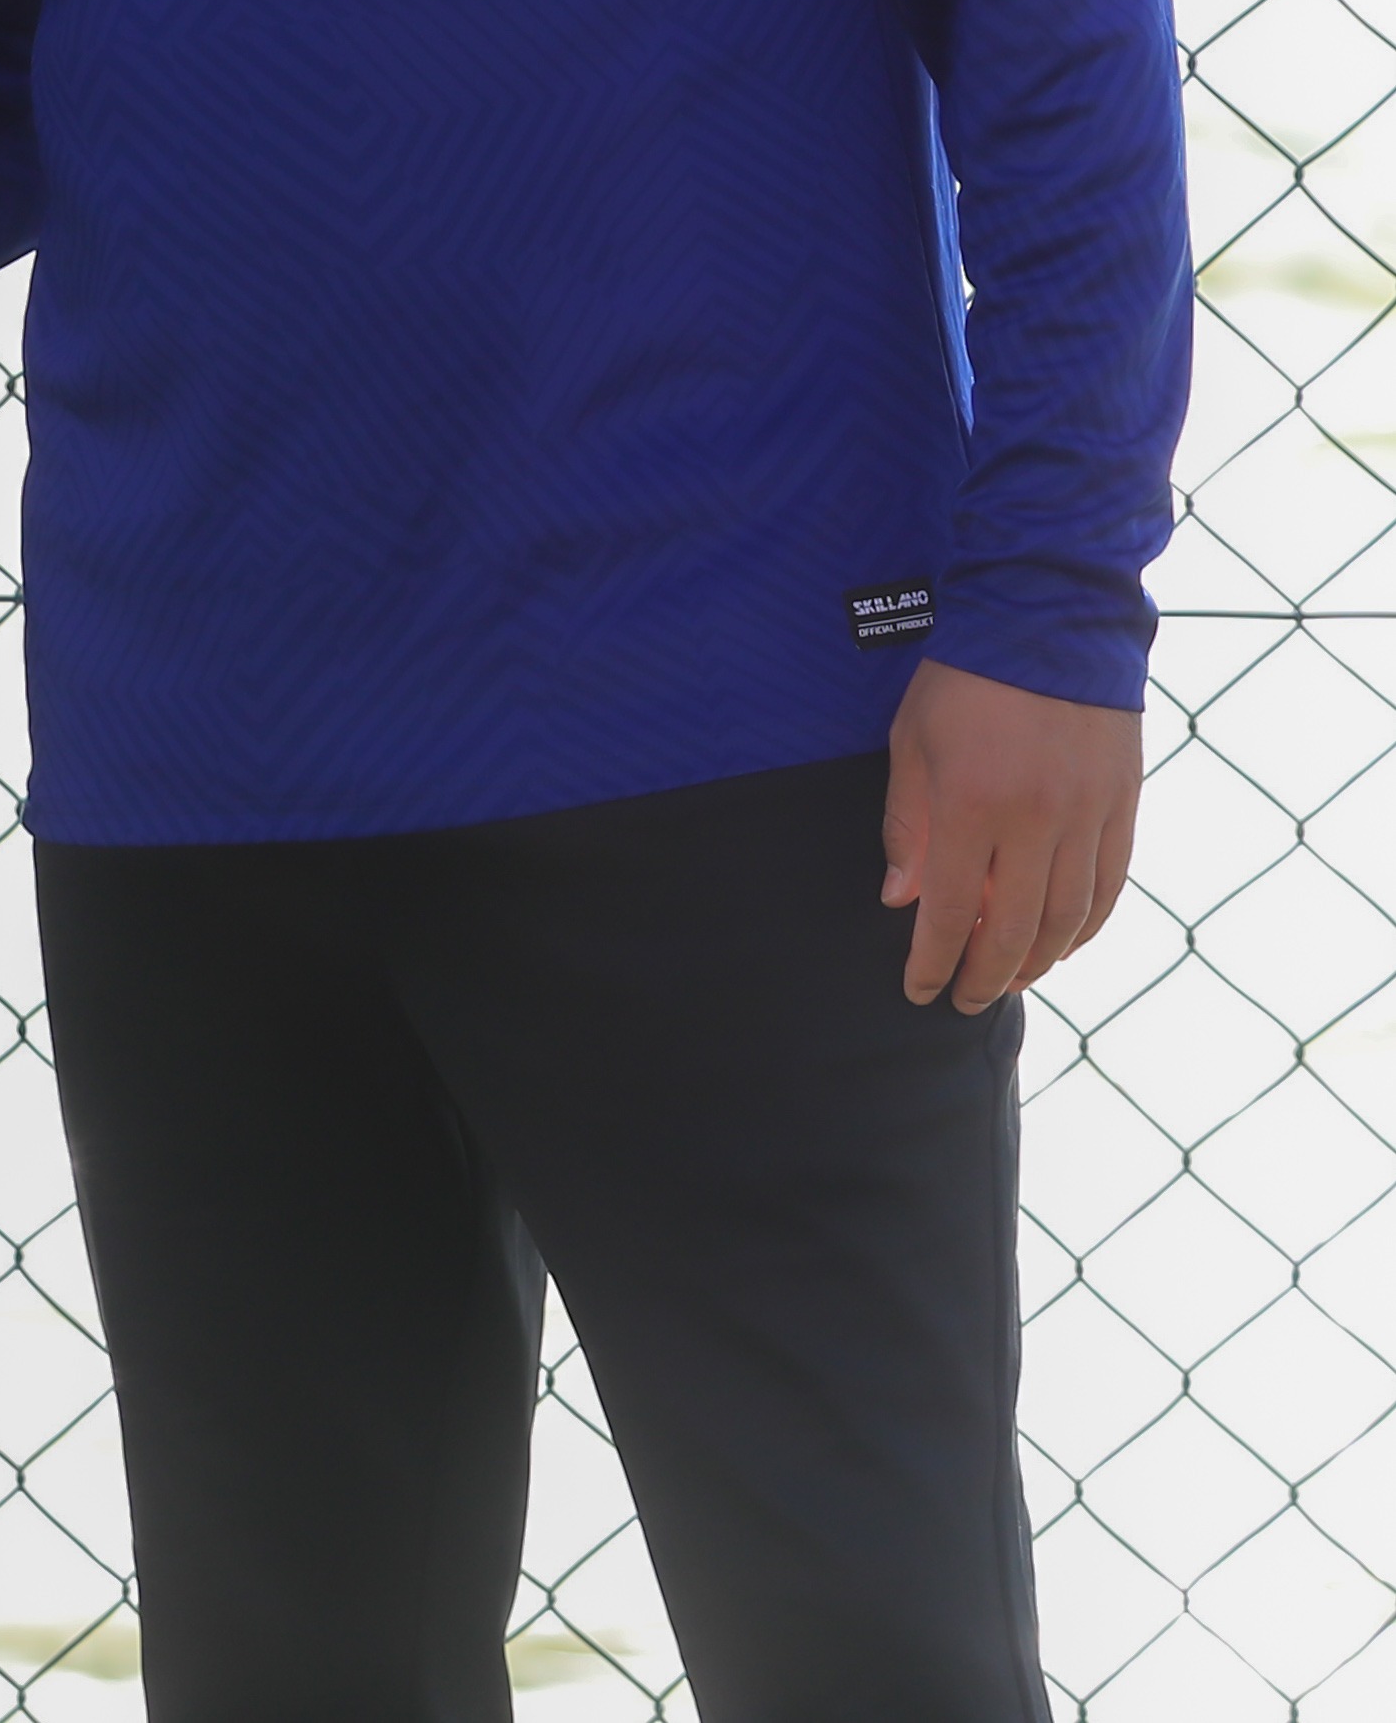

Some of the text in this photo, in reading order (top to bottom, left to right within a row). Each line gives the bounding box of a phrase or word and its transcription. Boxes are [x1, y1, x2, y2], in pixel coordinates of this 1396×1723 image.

[852, 589, 929, 616] SKILLANO
[858, 616, 934, 638] OFFICIAL PRODUCT
